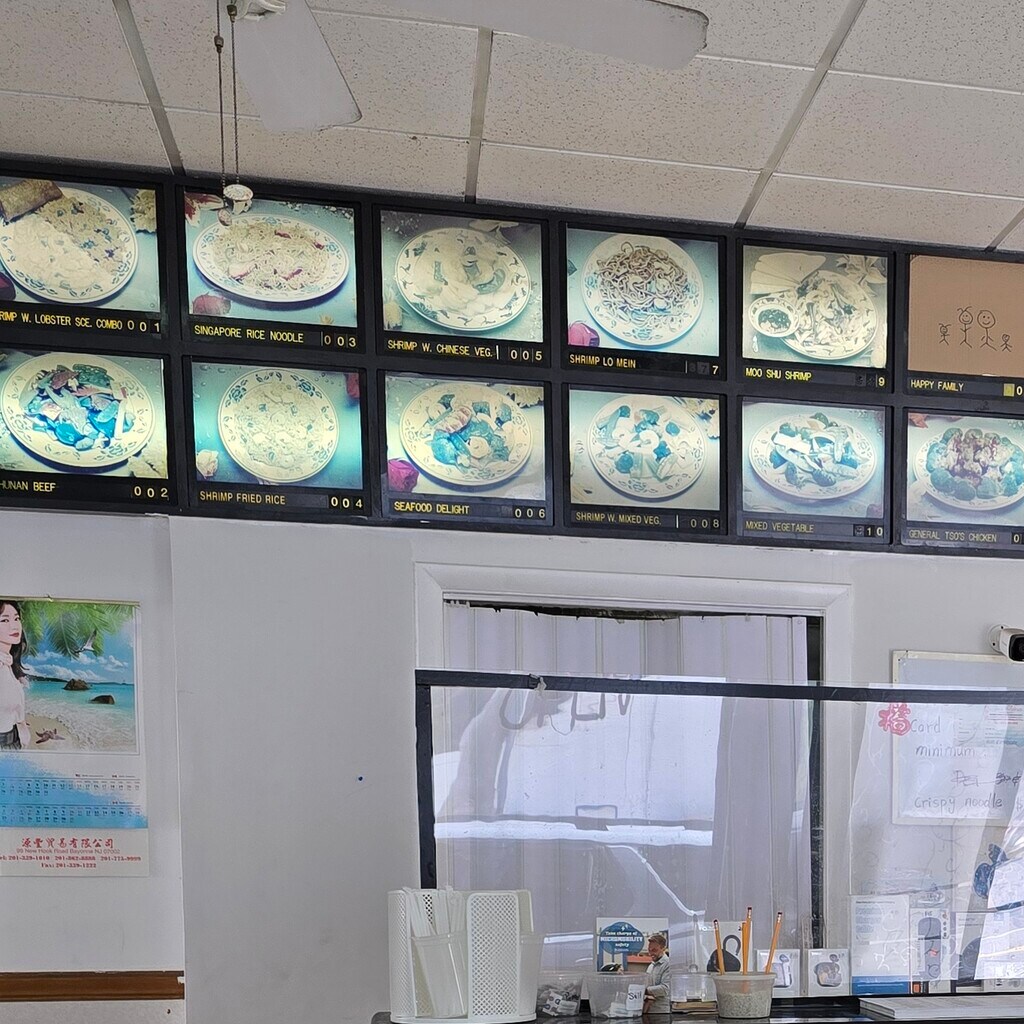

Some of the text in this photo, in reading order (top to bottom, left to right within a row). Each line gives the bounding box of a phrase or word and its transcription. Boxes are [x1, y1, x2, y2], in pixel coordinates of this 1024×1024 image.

[0, 311, 17, 322] RIMP
[22, 313, 31, 323] W.
[35, 314, 71, 326] LOBSTER
[75, 316, 92, 328] SCE.
[96, 318, 123, 330] COMBO
[194, 325, 241, 338] SINGAPORE
[246, 329, 265, 340] RICE
[270, 331, 304, 343] NOODLE
[388, 340, 417, 351] SHRIMP
[422, 342, 432, 353] W.
[436, 344, 470, 356] CHINESE
[475, 347, 493, 358] VEG.
[569, 354, 600, 365] SHRIMP
[603, 356, 614, 367] LO
[616, 358, 636, 369] MEIN
[745, 367, 763, 378] MOO
[766, 370, 782, 379] SHU
[785, 371, 812, 382] SHRIMP
[910, 379, 935, 390] HAPPY
[937, 381, 964, 392] FAMILY
[0, 479, 28, 490] HUNAN
[33, 481, 56, 492] BEEF
[200, 491, 233, 502] SHRIMP
[236, 494, 262, 504] FRIED
[265, 495, 286, 505] RICE
[394, 501, 432, 513] SEAFOOD
[436, 503, 469, 515] DELIGHT
[576, 512, 605, 522] SHRIMP
[607, 514, 617, 523] W.
[618, 514, 642, 524] MIXED
[643, 515, 662, 526] VEG.
[745, 520, 768, 530] MIXED
[772, 522, 815, 534] VEGETABLE
[909, 529, 940, 540] GENERAL
[945, 531, 965, 541] TSO'S
[968, 532, 997, 543] CHICKEN
[911, 716, 941, 734] Card
[915, 745, 976, 758] minimum
[964, 793, 1003, 808] noodle
